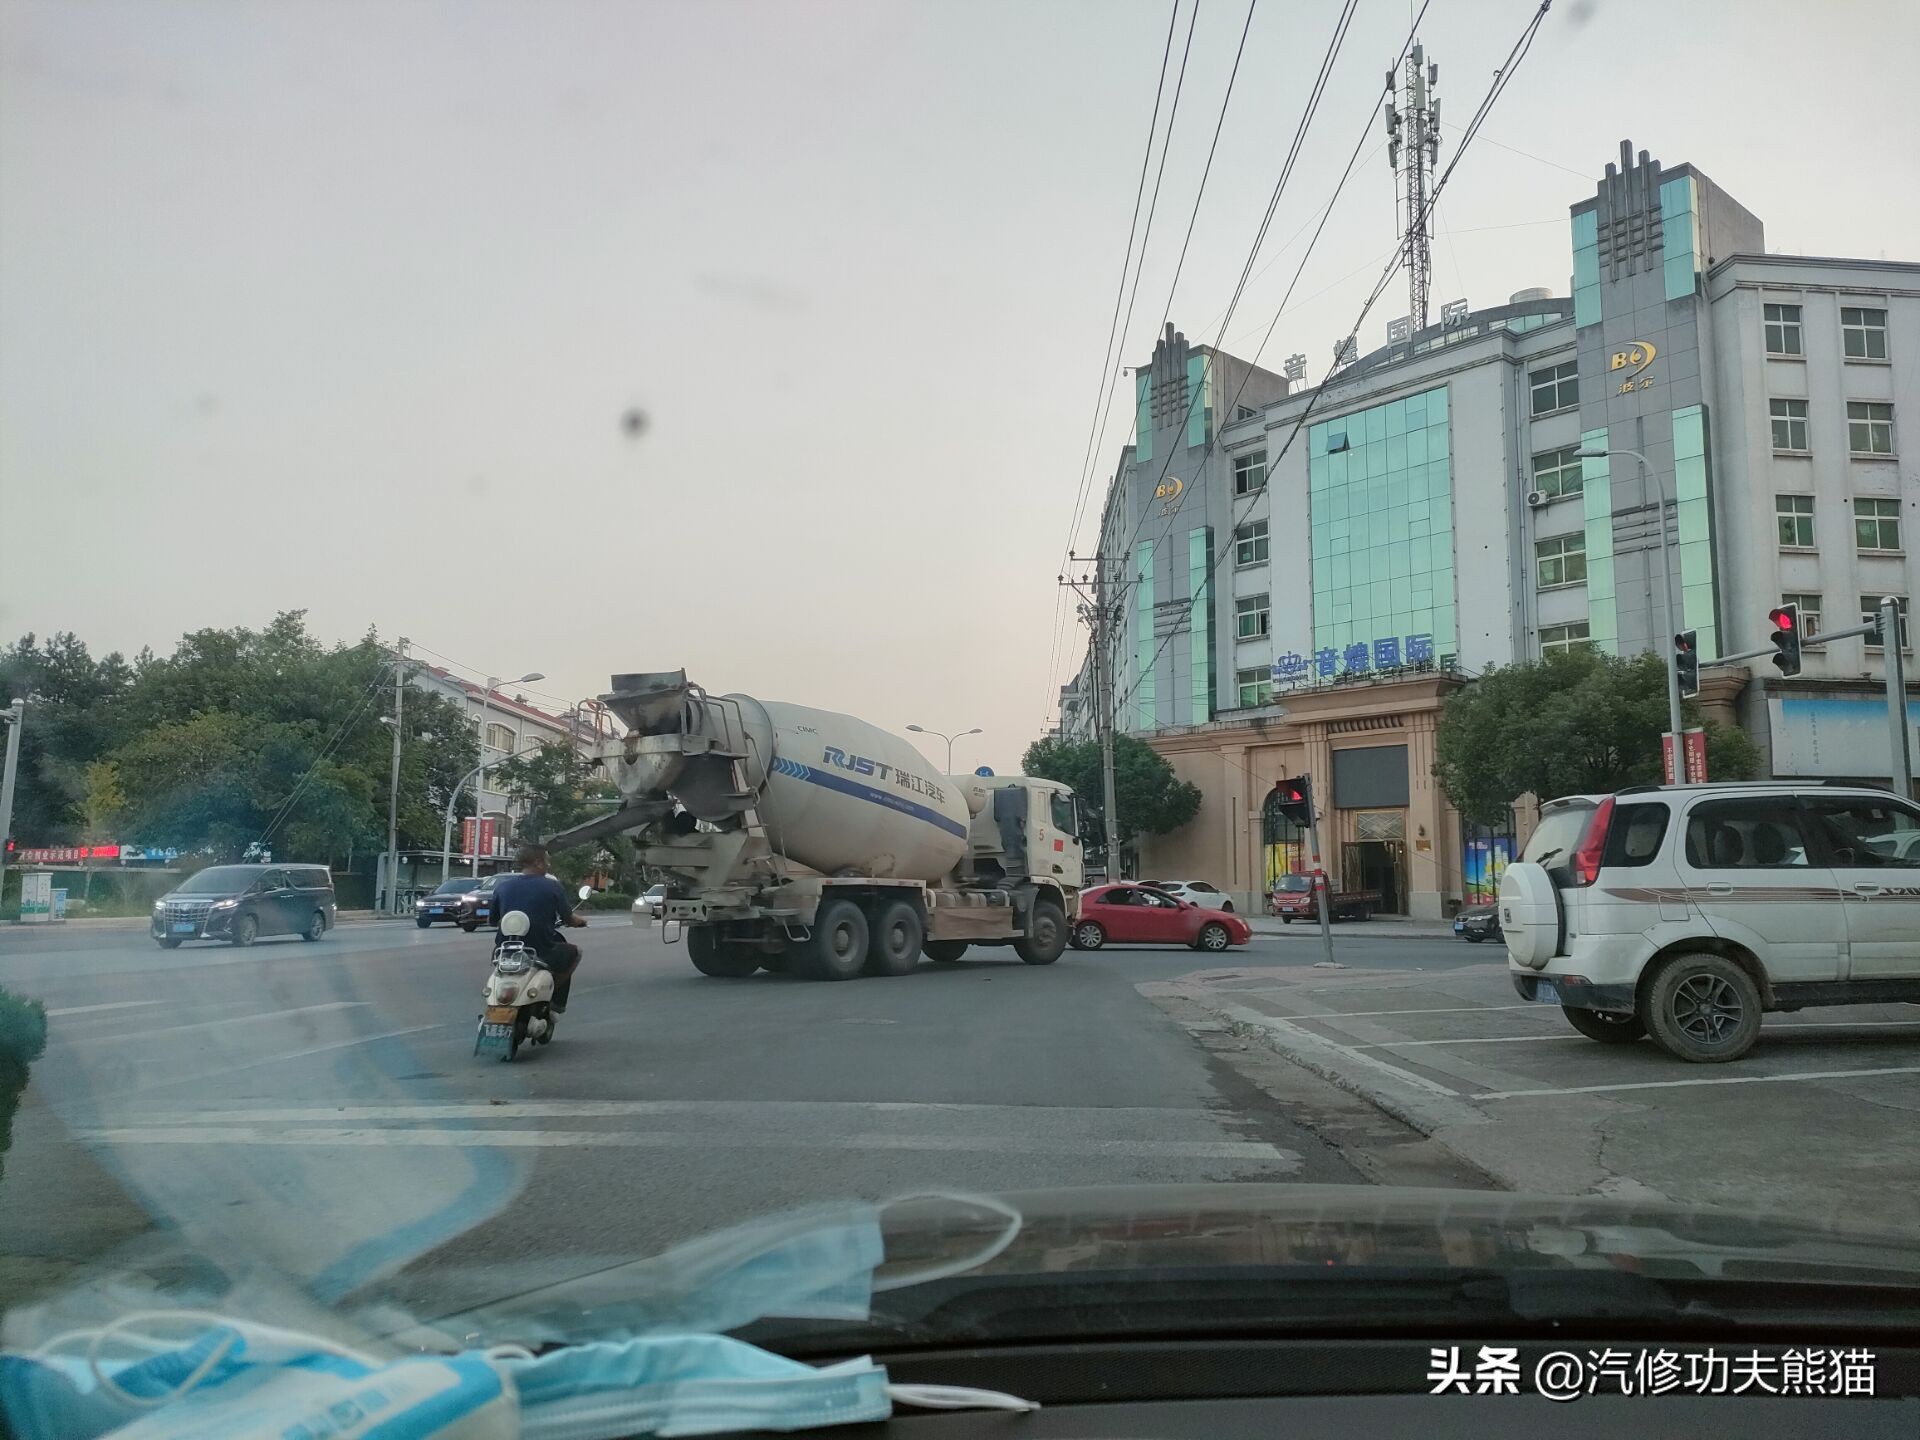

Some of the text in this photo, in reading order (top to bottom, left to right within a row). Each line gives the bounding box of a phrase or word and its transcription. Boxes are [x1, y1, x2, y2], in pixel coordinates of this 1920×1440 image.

[895, 768, 945, 804] 瑞江汽车
[1039, 828, 1045, 841] 5
